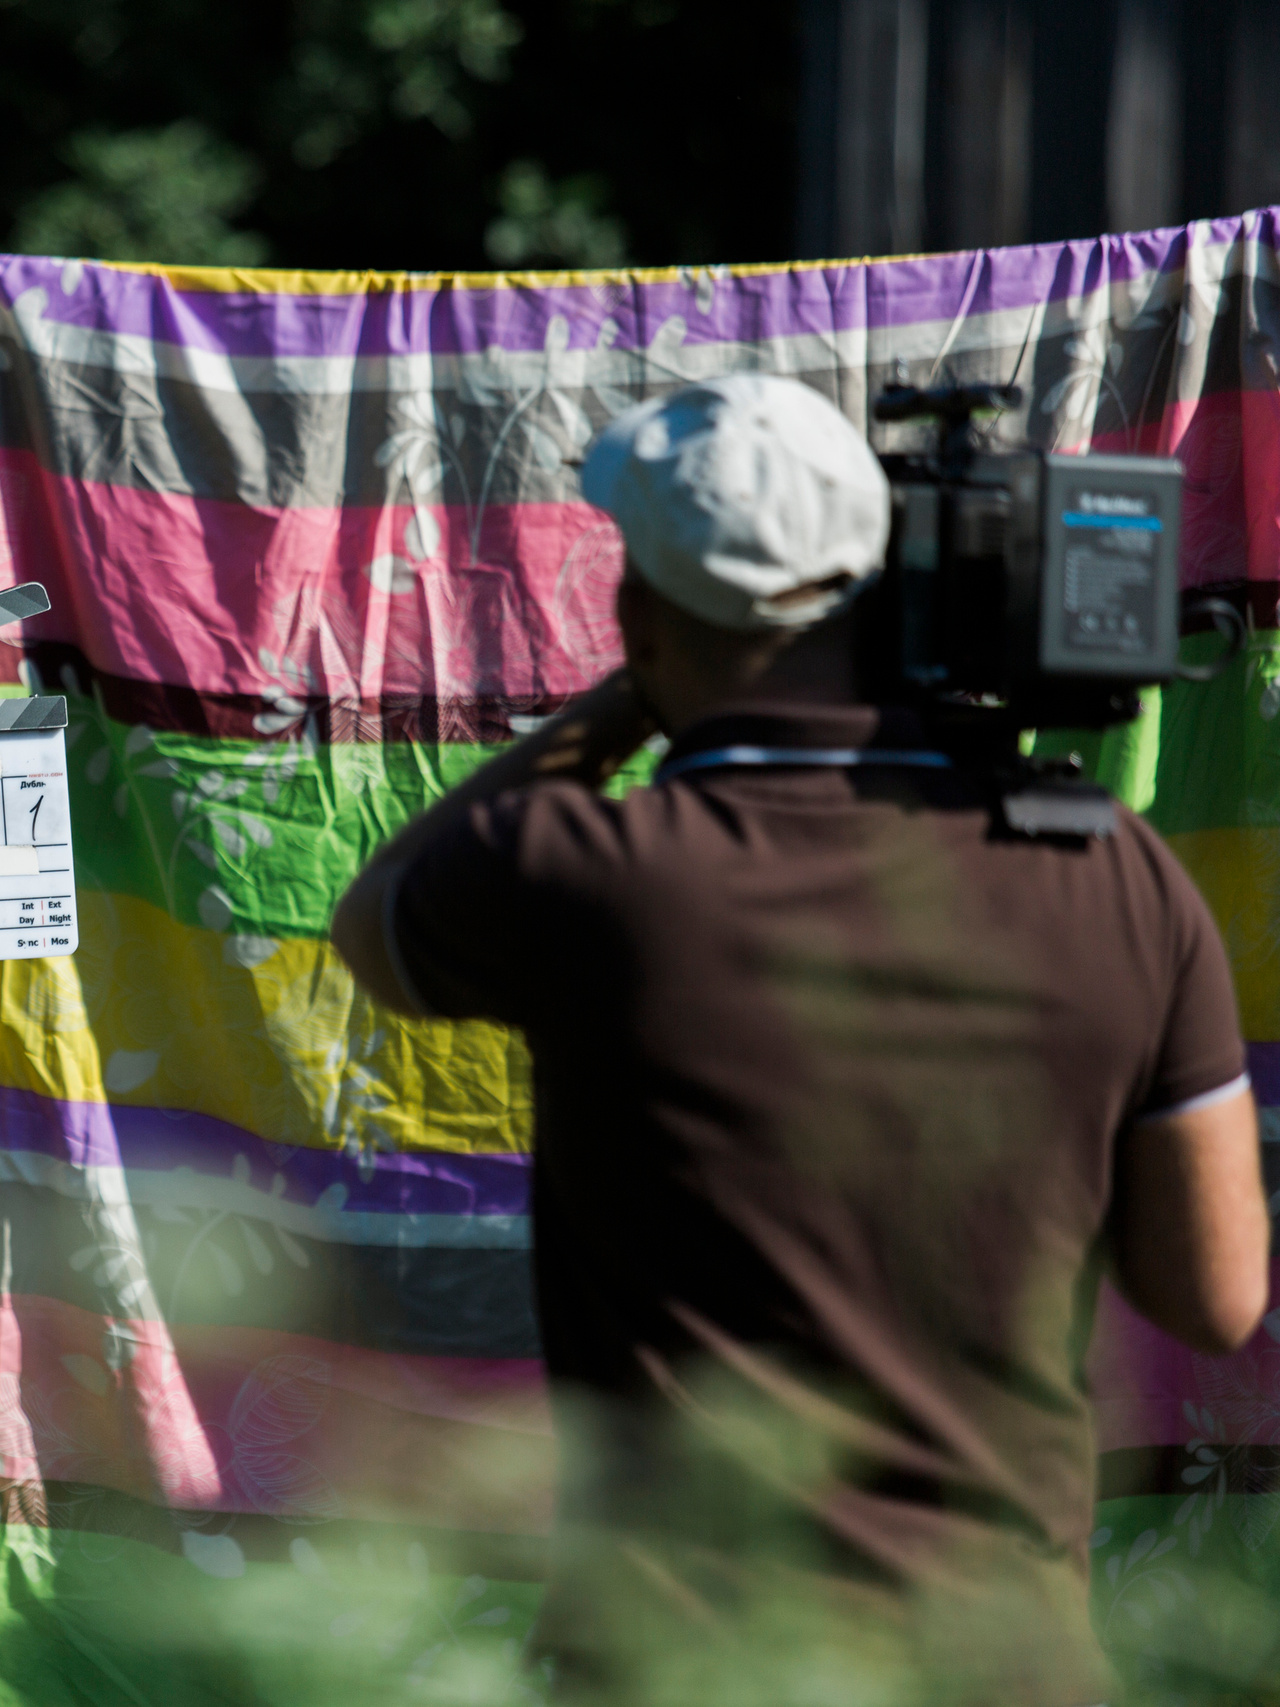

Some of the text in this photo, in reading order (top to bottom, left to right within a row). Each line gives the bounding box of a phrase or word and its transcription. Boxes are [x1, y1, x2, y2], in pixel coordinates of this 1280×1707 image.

[29, 795, 44, 841] 1
[19, 914, 72, 925] Day Night
[51, 937, 69, 945] Mos
